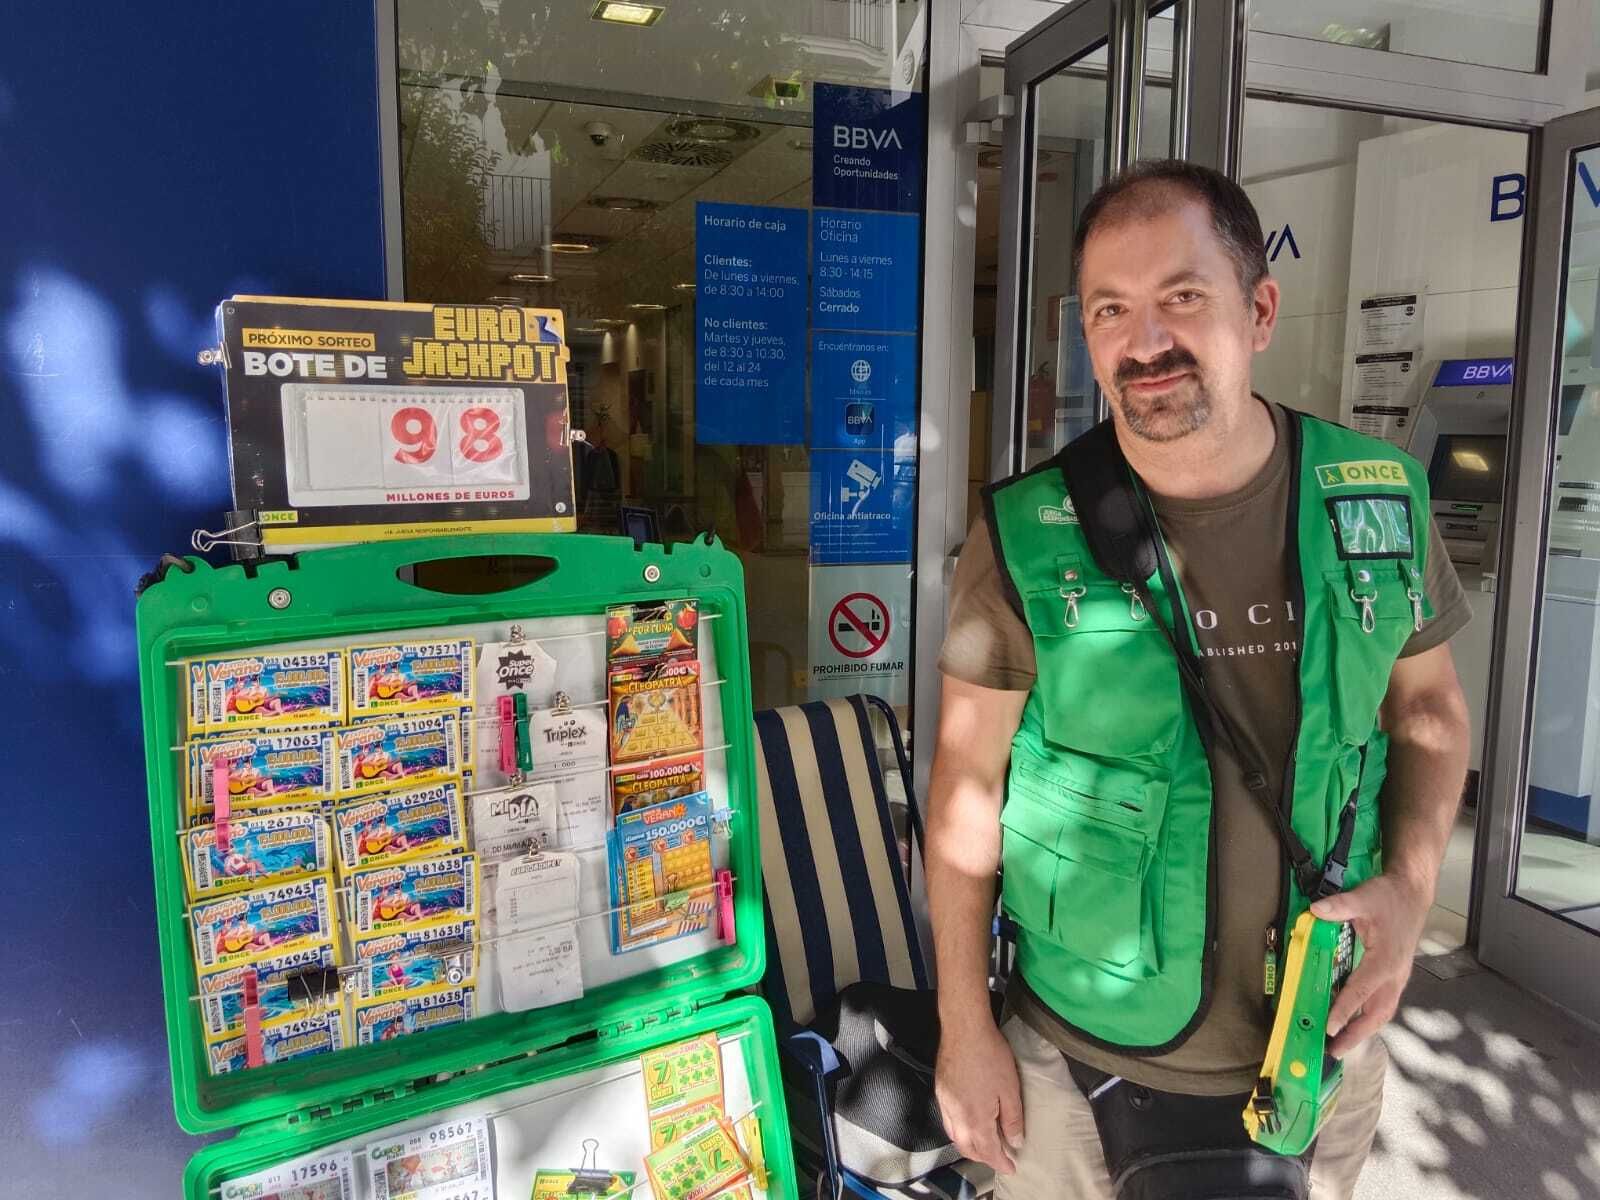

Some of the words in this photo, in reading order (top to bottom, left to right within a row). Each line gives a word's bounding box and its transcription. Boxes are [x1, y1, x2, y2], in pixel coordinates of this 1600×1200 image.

[833, 125, 902, 150] BBVA
[834, 154, 871, 167] Creando
[834, 167, 898, 181] Oportunidades
[704, 215, 746, 228] Horario
[748, 219, 762, 229] de
[764, 220, 786, 232] caja
[820, 217, 862, 231] Horario
[820, 230, 858, 243] Oficina
[704, 254, 752, 268] Clientes:
[820, 251, 849, 264] Lunes
[851, 255, 857, 265] a
[859, 254, 893, 266] viernes
[704, 269, 719, 280] De
[721, 269, 749, 282] lunes
[751, 273, 758, 283] a
[819, 267, 842, 278] 8:30
[850, 268, 873, 280] 14:15
[704, 285, 717, 295] de
[719, 285, 744, 297] 8:30
[756, 286, 784, 298] 14:00
[820, 286, 861, 299] Sábados
[819, 302, 860, 313] Cerrado
[434, 306, 522, 342] EURO
[704, 318, 720, 329] No
[722, 318, 768, 330] clientes:
[248, 330, 313, 347] PRÓXIMO
[317, 335, 372, 348] SORTEO
[704, 332, 741, 345] Martes
[743, 335, 750, 346] y
[751, 335, 786, 346] jueves,
[818, 340, 875, 352] Encuéntranos
[877, 344, 889, 352] en:
[704, 347, 717, 357] de
[719, 347, 744, 359] 8:30
[243, 352, 336, 378] BOTE
[344, 354, 387, 379] DE
[403, 342, 555, 380] JACKPOT
[704, 361, 720, 372] del
[723, 361, 735, 372] 12
[736, 362, 745, 373] al
[748, 362, 761, 373] 24
[704, 375, 717, 386] de
[719, 376, 745, 387] cada
[747, 378, 769, 388] mes
[847, 415, 872, 425] BBVA
[1347, 465, 1402, 480] ONCE
[386, 492, 450, 502] MILLONES
[455, 491, 471, 501] DE
[475, 489, 515, 500] EUROS
[814, 511, 844, 520] Oficina
[847, 511, 891, 520] antiatraco
[354, 651, 401, 667] Verano
[420, 644, 459, 655] 97571
[208, 663, 262, 681] Verano
[282, 655, 327, 668] 04382
[813, 663, 868, 675] PROHIBIDO
[870, 661, 904, 671] FUMAR
[629, 678, 683, 692] CLEOPATRA
[338, 730, 384, 749] Verano
[402, 718, 441, 733] 31094
[544, 726, 587, 744] Triplex
[277, 735, 319, 748] 17063
[650, 765, 691, 779] 100.000€
[633, 776, 687, 793] CLEOPATRA
[339, 804, 387, 827] Verano
[404, 789, 443, 805] 62920
[490, 799, 509, 817] MI
[509, 797, 538, 820] DÍA
[267, 816, 311, 829] 26716
[646, 816, 706, 840] 150.000€
[357, 872, 404, 891] Verano
[423, 860, 460, 873] 81638
[195, 902, 248, 925] Verano
[269, 884, 311, 899] 74945
[359, 938, 405, 959] Verano
[424, 924, 461, 939] 81638
[276, 950, 317, 966] 74945
[360, 1004, 405, 1024] Verano
[424, 991, 461, 1006] 81638
[429, 1122, 473, 1143] 98567
[292, 1160, 338, 1181] 17596
